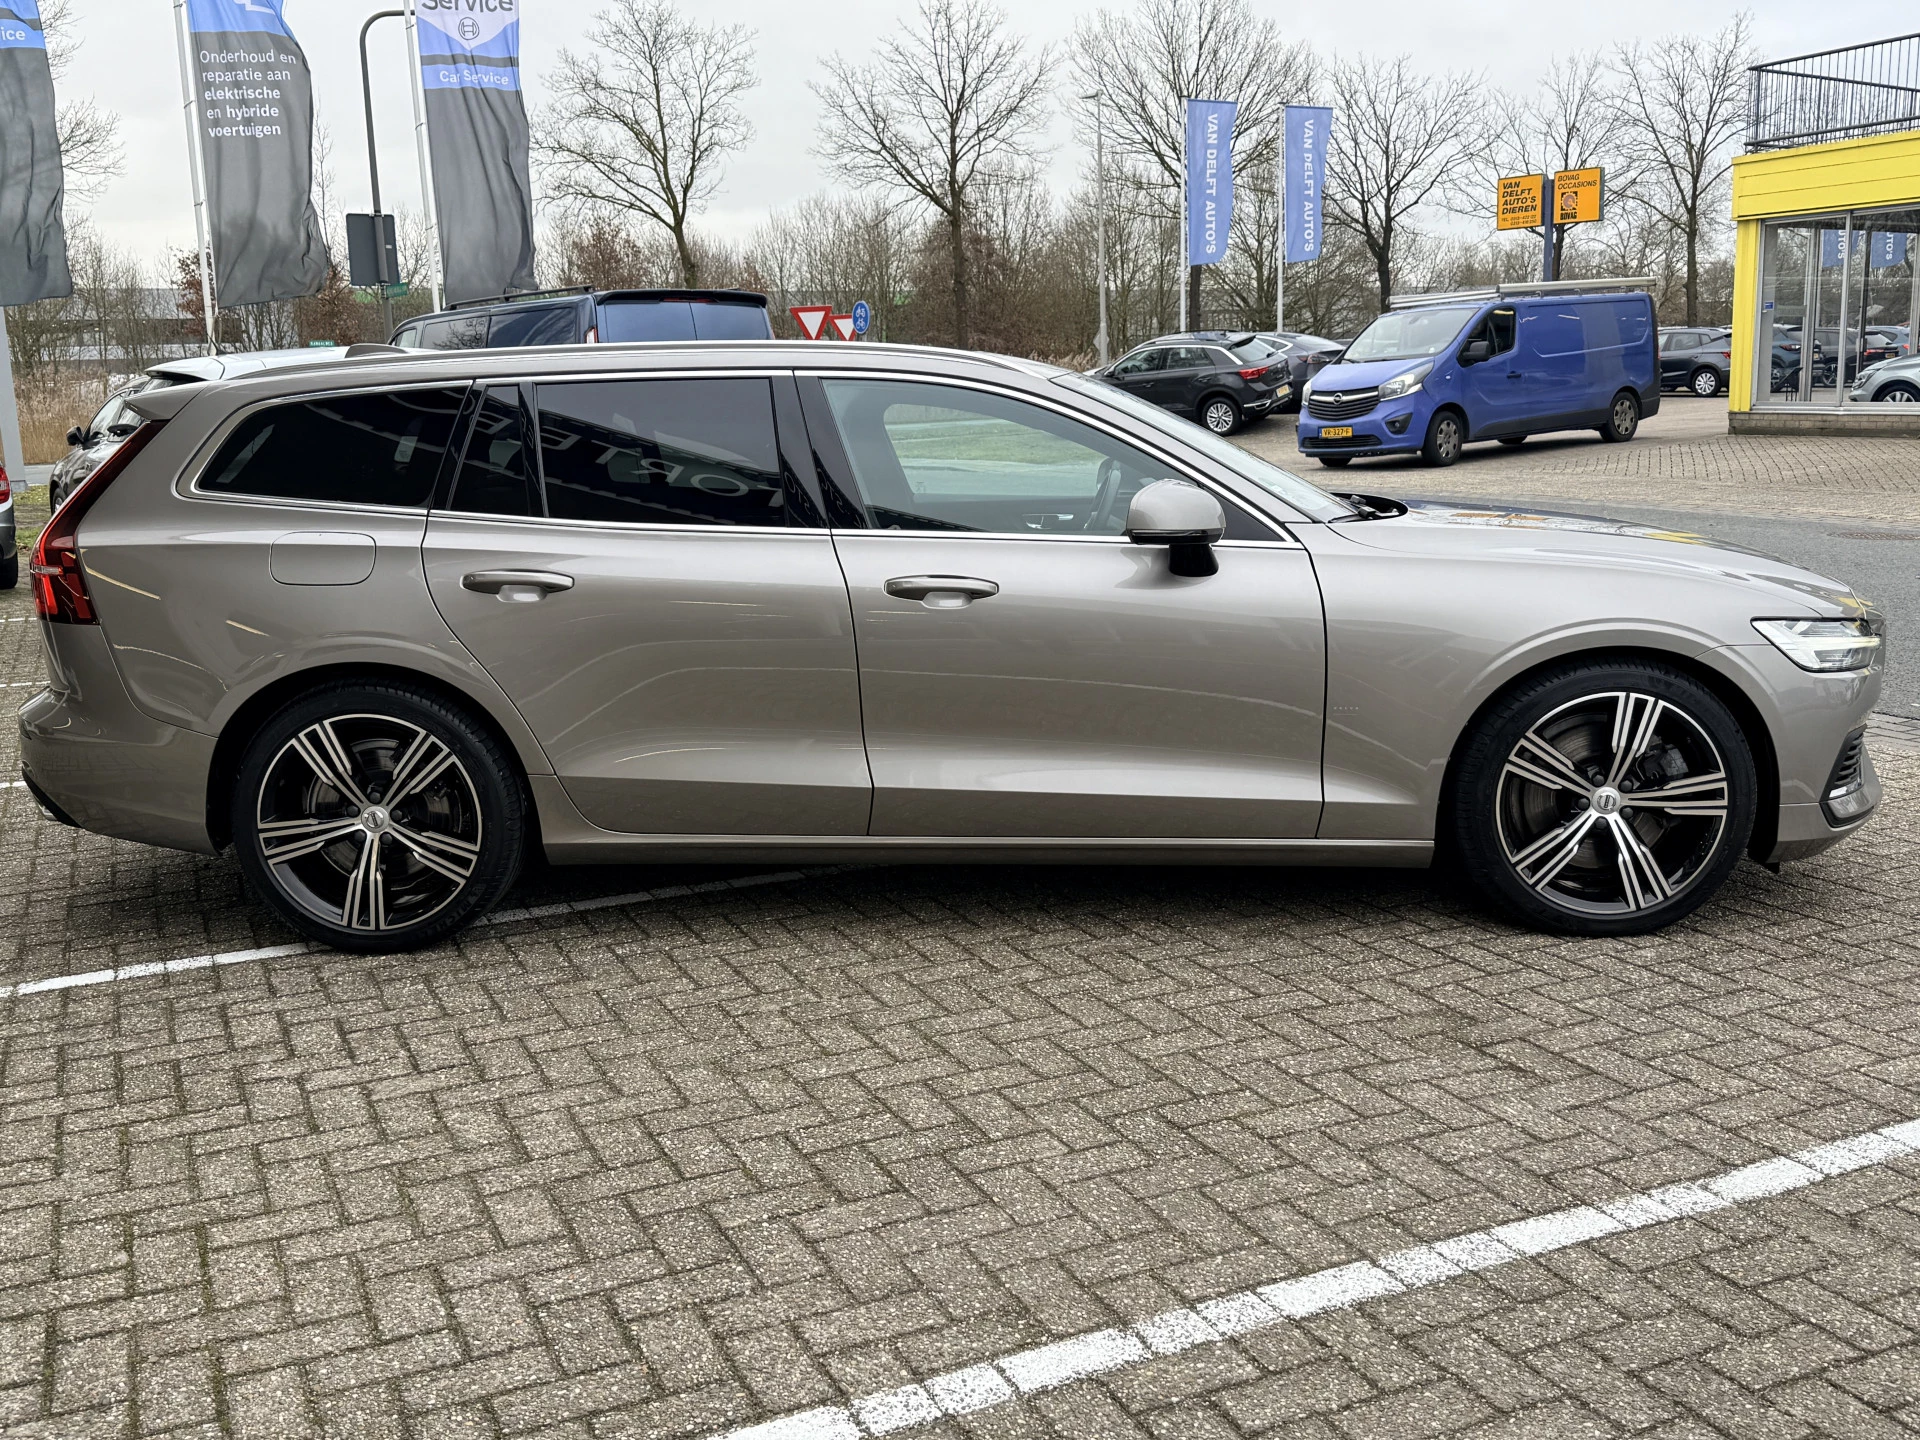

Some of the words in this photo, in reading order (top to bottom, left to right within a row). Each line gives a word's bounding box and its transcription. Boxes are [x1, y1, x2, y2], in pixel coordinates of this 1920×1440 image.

[200, 49, 275, 63] Onderhoud
[279, 53, 297, 64] en
[202, 68, 263, 84] reparatie
[267, 70, 291, 81] aan
[204, 86, 281, 101] elektrische
[207, 108, 222, 119] en
[226, 104, 279, 121] hybride
[208, 122, 281, 138] voertuigen
[1207, 113, 1218, 144] VAN
[1304, 119, 1314, 148] VAN
[1206, 149, 1217, 196] DELFT
[1304, 153, 1313, 197] DELFT
[1558, 174, 1580, 182] BOVAG
[1502, 188, 1533, 198] DELFT
[1503, 181, 1520, 189] VAN
[1557, 180, 1598, 190] OCCASIONS
[1501, 204, 1537, 215] DIEREN
[1502, 196, 1537, 207] AUTO'S
[1206, 201, 1216, 254] AUTO'S
[1304, 201, 1314, 252] AUTO'S
